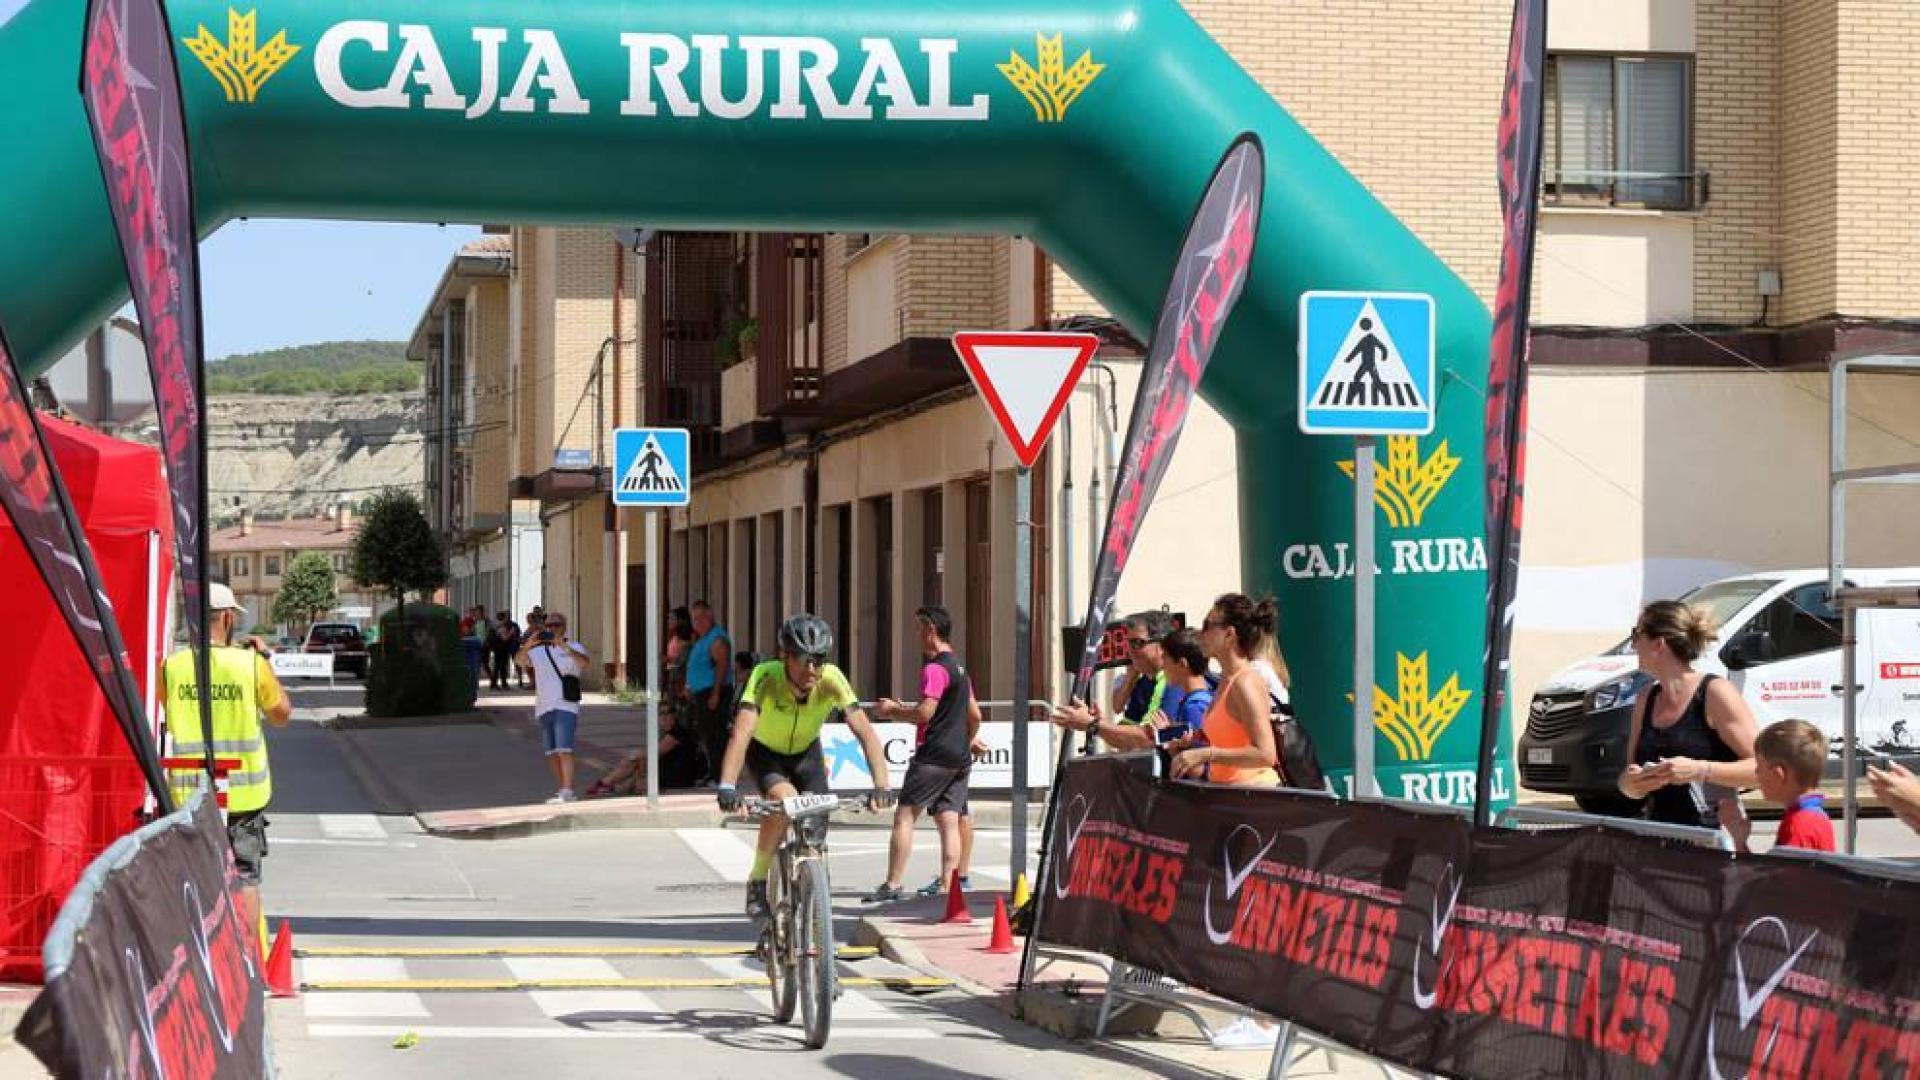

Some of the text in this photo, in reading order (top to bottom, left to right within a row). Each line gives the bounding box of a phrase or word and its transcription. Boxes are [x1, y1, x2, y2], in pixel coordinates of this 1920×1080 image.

[314, 20, 990, 121] CAJA RURAL
[1391, 536, 1488, 573] RURA
[1401, 767, 1510, 805] RURL
